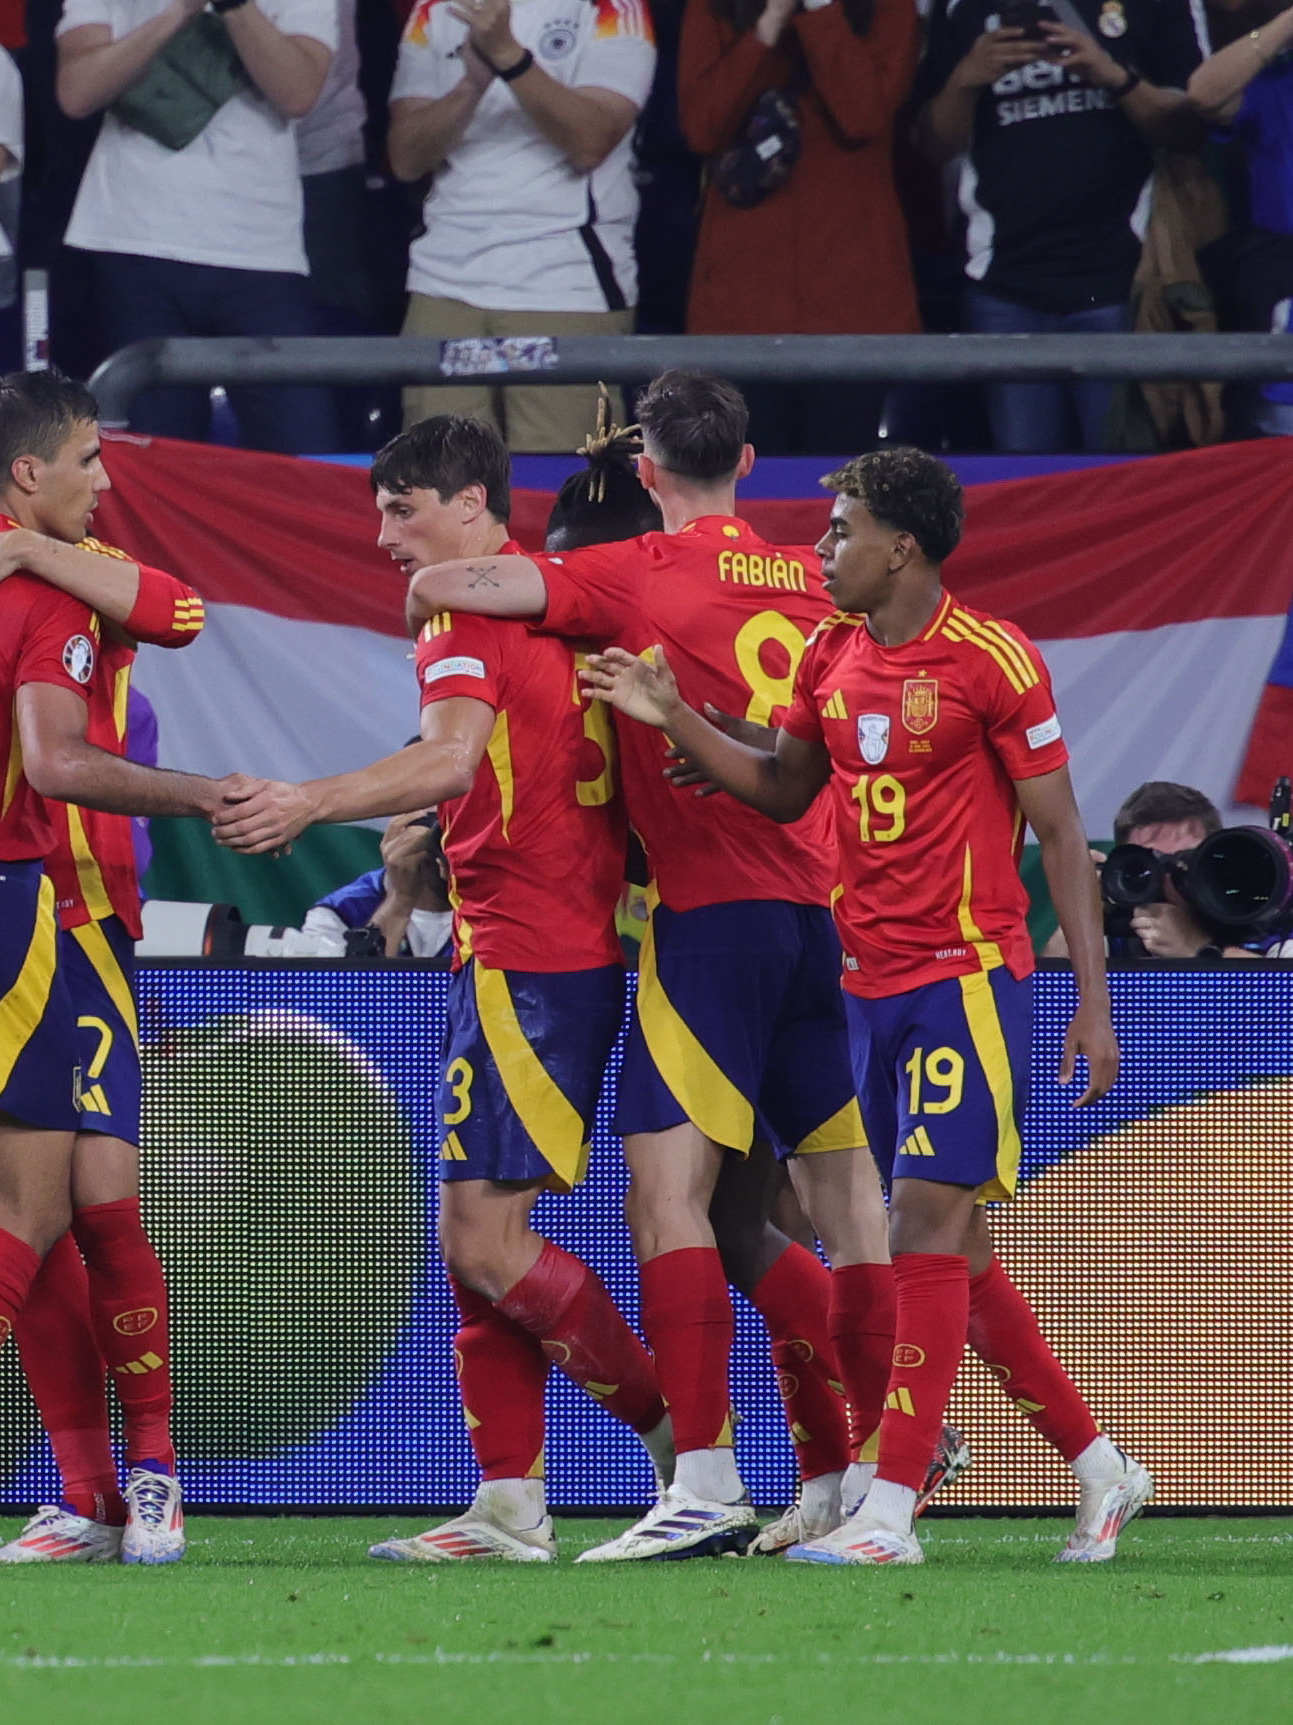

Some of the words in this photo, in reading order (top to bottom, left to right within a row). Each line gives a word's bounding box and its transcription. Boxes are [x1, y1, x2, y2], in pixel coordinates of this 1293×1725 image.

[851, 774, 905, 842] 19
[77, 1016, 113, 1079] 7
[905, 1046, 964, 1115] 19
[443, 1057, 473, 1125] 3
